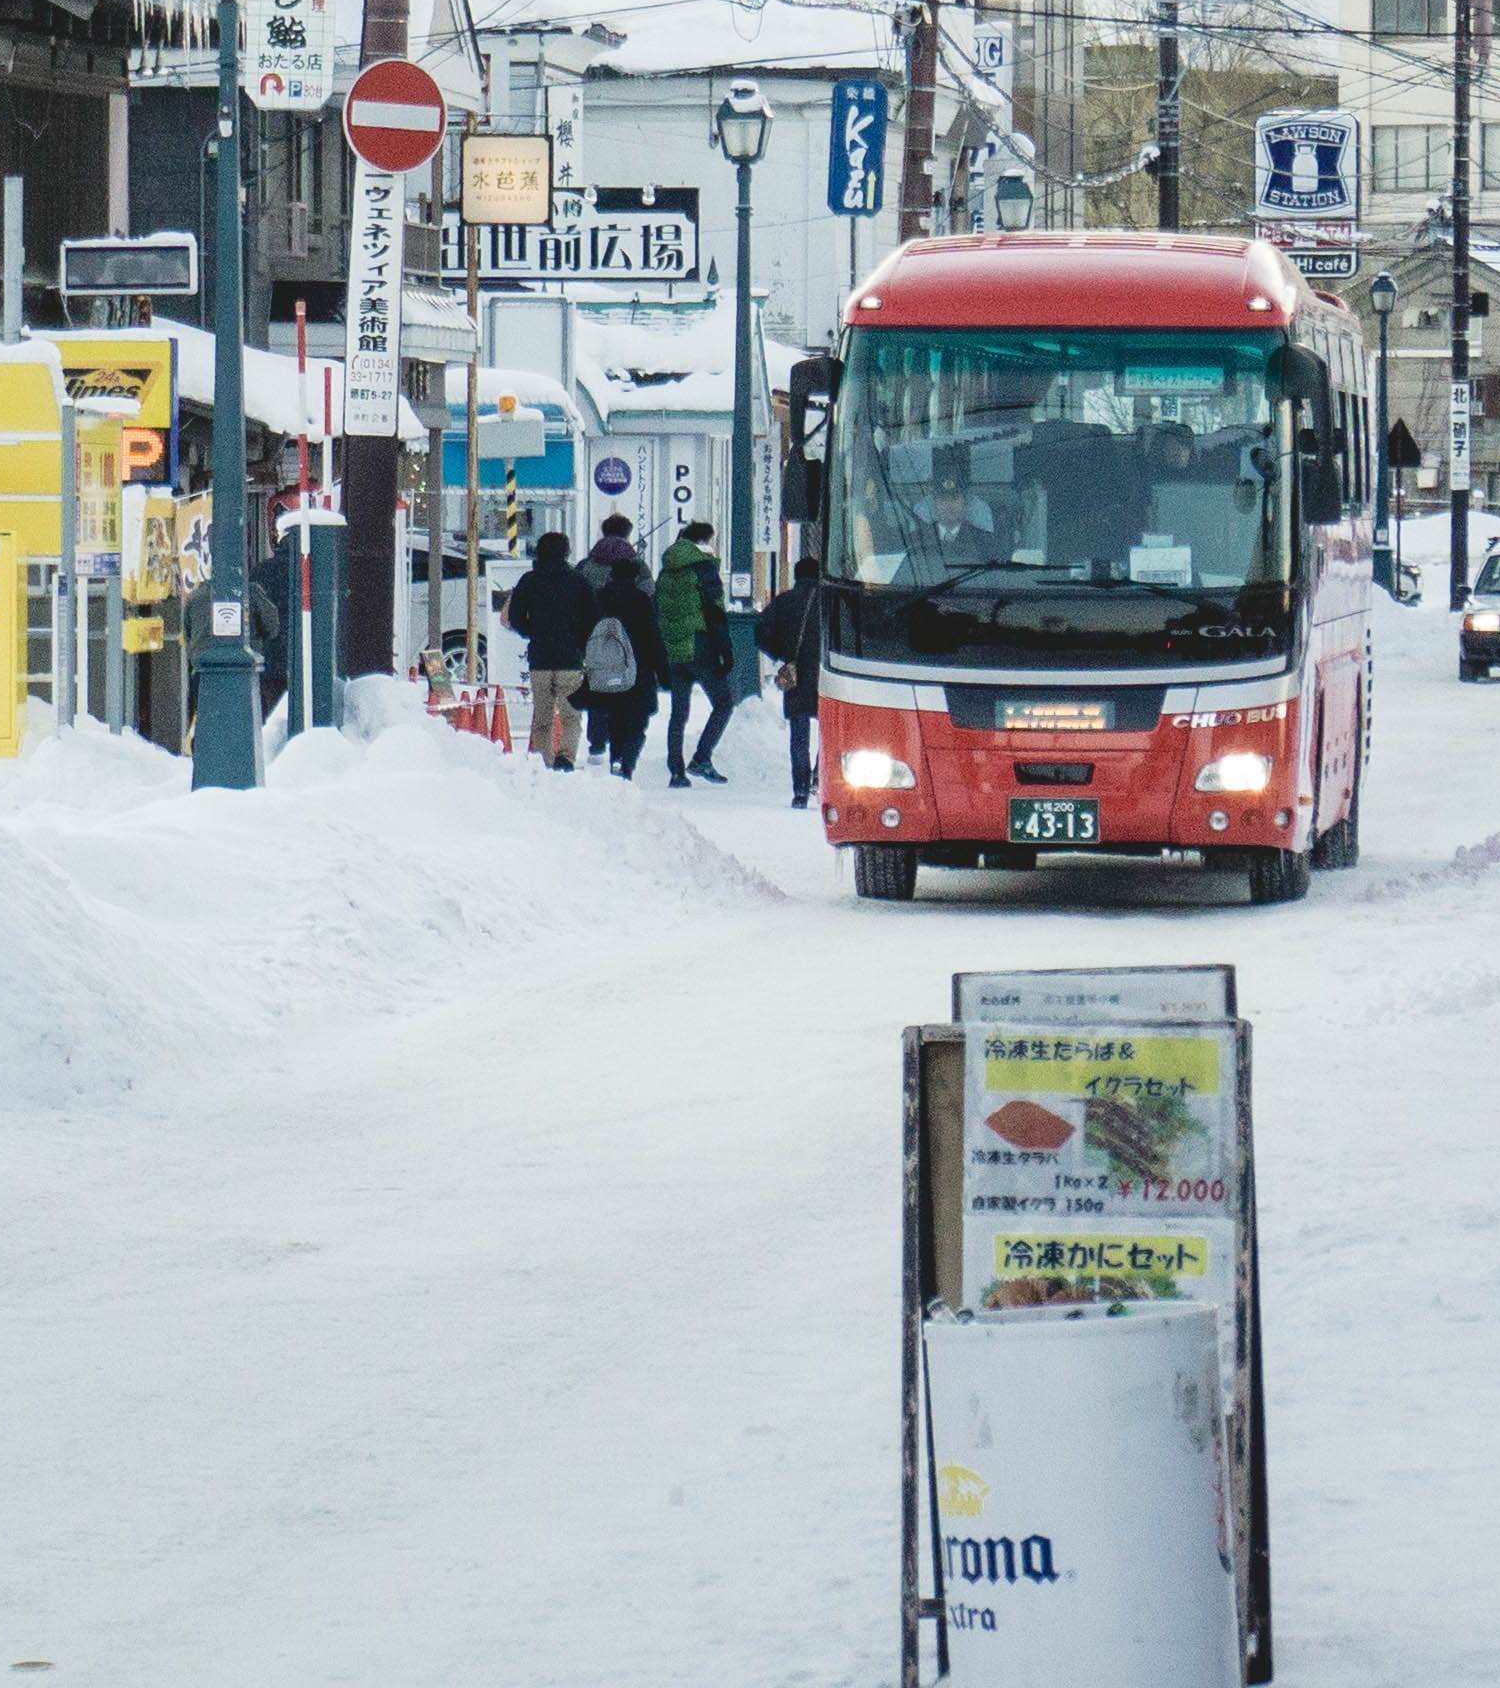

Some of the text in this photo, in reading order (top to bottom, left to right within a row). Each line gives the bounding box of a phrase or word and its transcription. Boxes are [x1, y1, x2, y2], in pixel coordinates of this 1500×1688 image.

[258, 53, 323, 71] おたる店
[1267, 122, 1343, 144] LAWSON
[472, 170, 541, 191] 水芭蕉
[1268, 189, 1342, 207] STATION
[441, 222, 686, 272] 出世前広場
[121, 428, 164, 481] P
[673, 464, 693, 538] POL
[1198, 625, 1277, 639] GALA
[1025, 812, 1095, 839] 43-13
[1084, 1076, 1196, 1098] イクラセット
[1003, 1239, 1200, 1271] 冷凍かにセット
[943, 1533, 1059, 1585] rona
[949, 1601, 997, 1631] xtra
